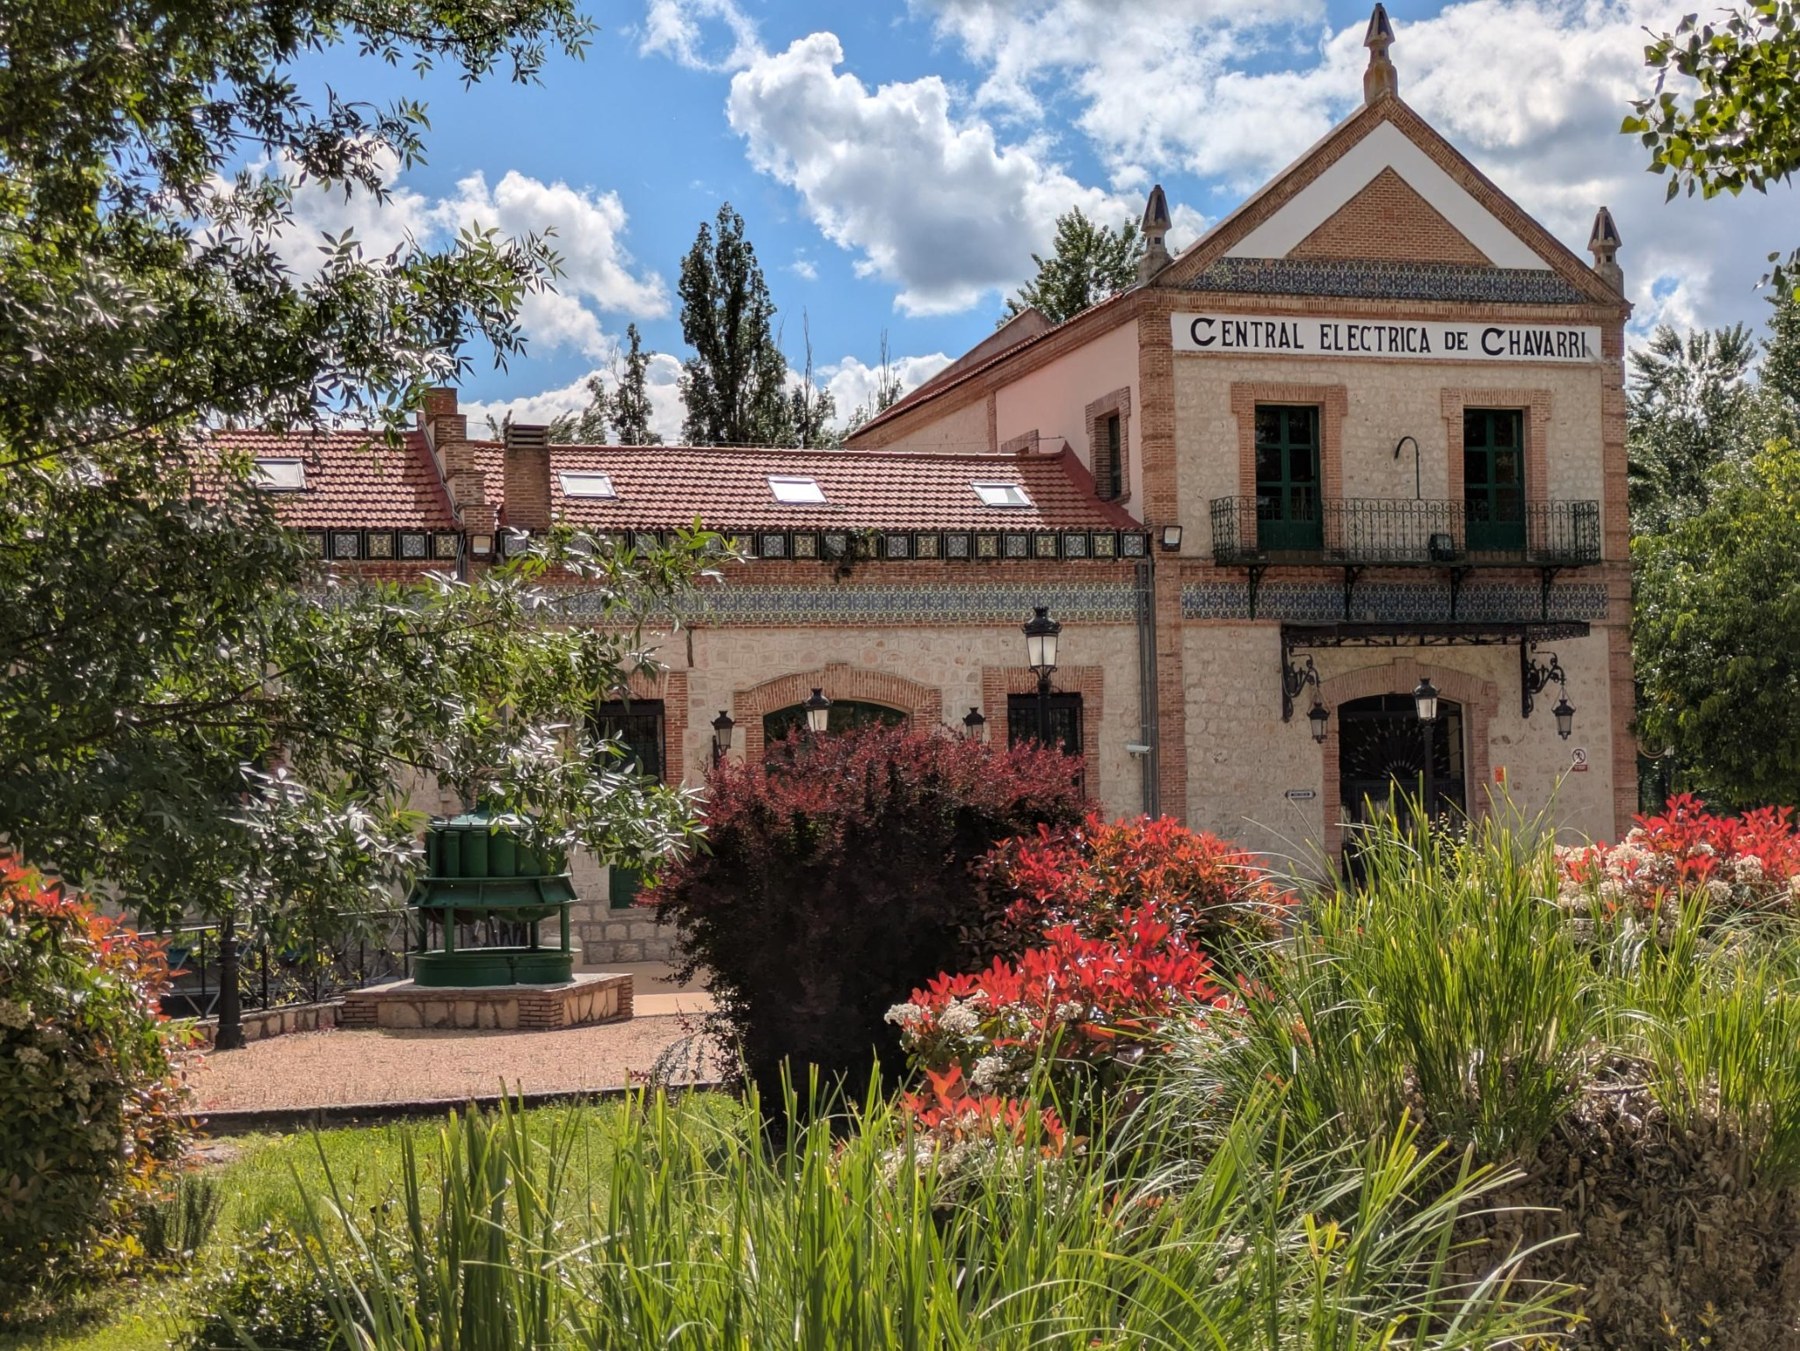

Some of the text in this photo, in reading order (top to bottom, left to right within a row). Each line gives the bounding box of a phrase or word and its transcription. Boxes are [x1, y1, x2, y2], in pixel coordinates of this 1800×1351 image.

[1191, 317, 1587, 358] CENTRAL ELECTRICA DE CHAVARRI
